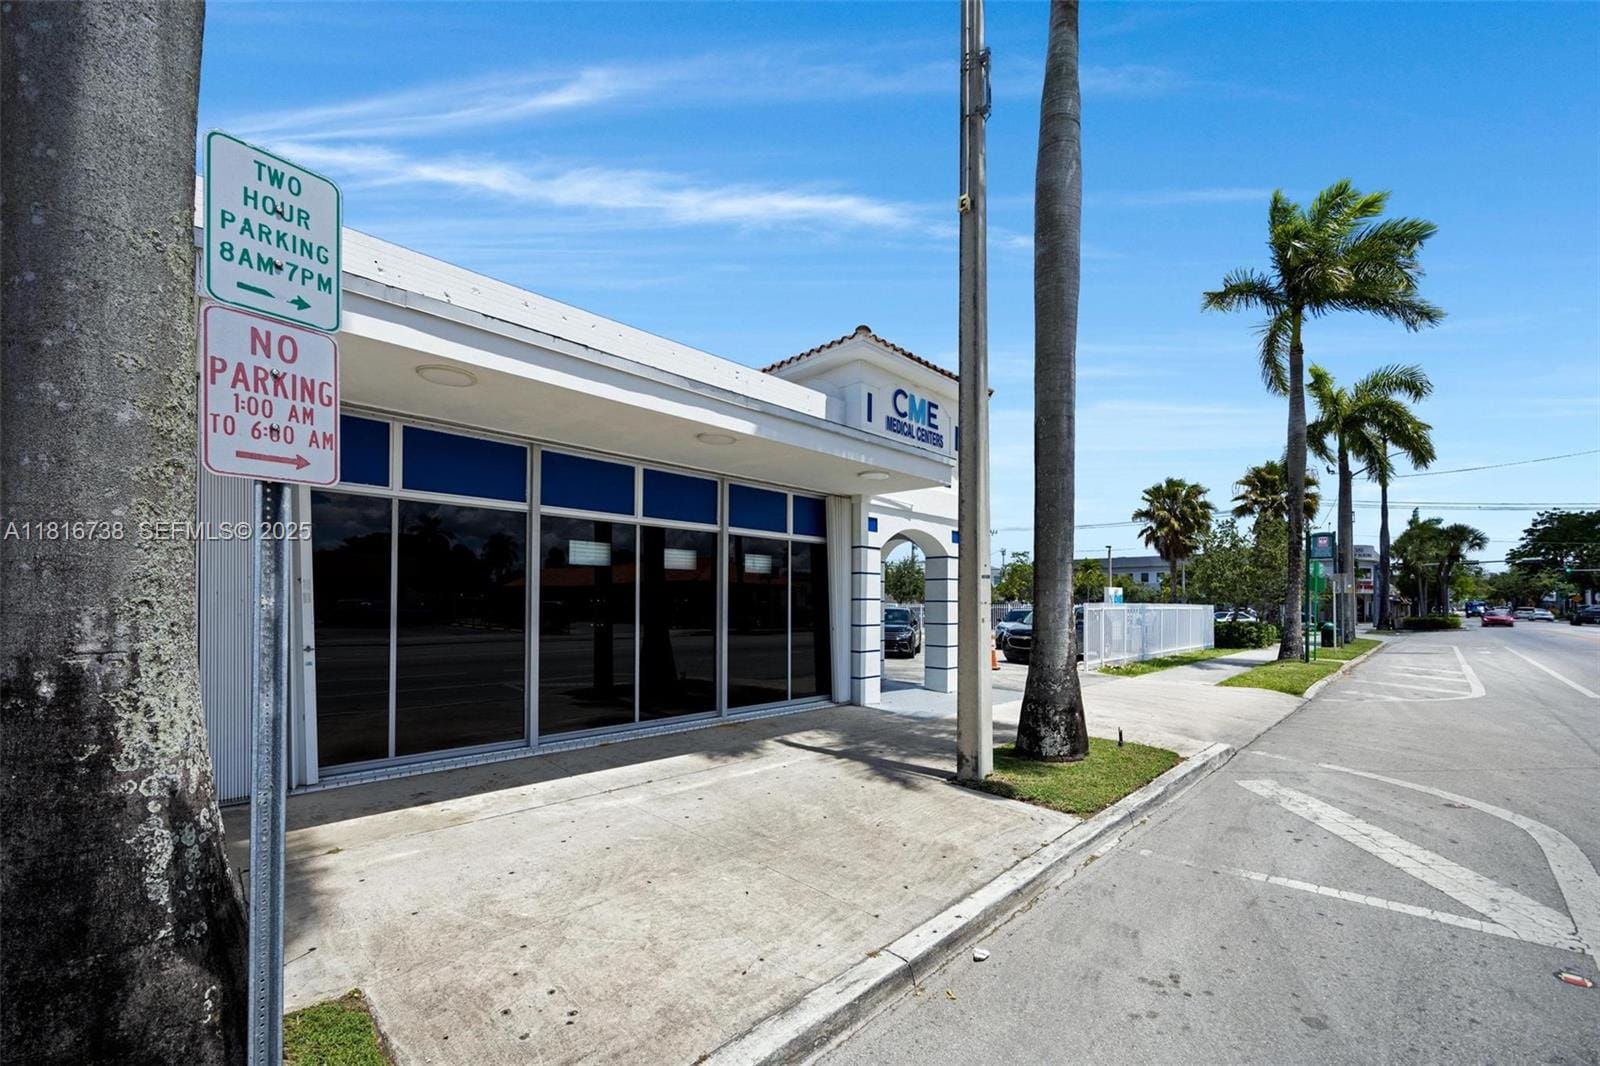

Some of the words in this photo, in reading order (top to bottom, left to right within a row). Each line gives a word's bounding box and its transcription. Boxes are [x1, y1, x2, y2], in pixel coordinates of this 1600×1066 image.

[253, 159, 302, 197] TWO
[243, 186, 310, 231] HOUR
[220, 209, 329, 265] PARKING
[219, 241, 332, 294] 8AM7PM
[250, 326, 298, 364] NO
[209, 355, 333, 407] PARKING
[233, 393, 273, 419] 1:00
[287, 404, 315, 426] AM
[892, 388, 939, 430] CME
[209, 413, 236, 436] TO
[251, 421, 295, 445] 6:00
[308, 430, 334, 451] AM
[885, 415, 915, 439] MEDICAL
[916, 427, 944, 448] CENTERS
